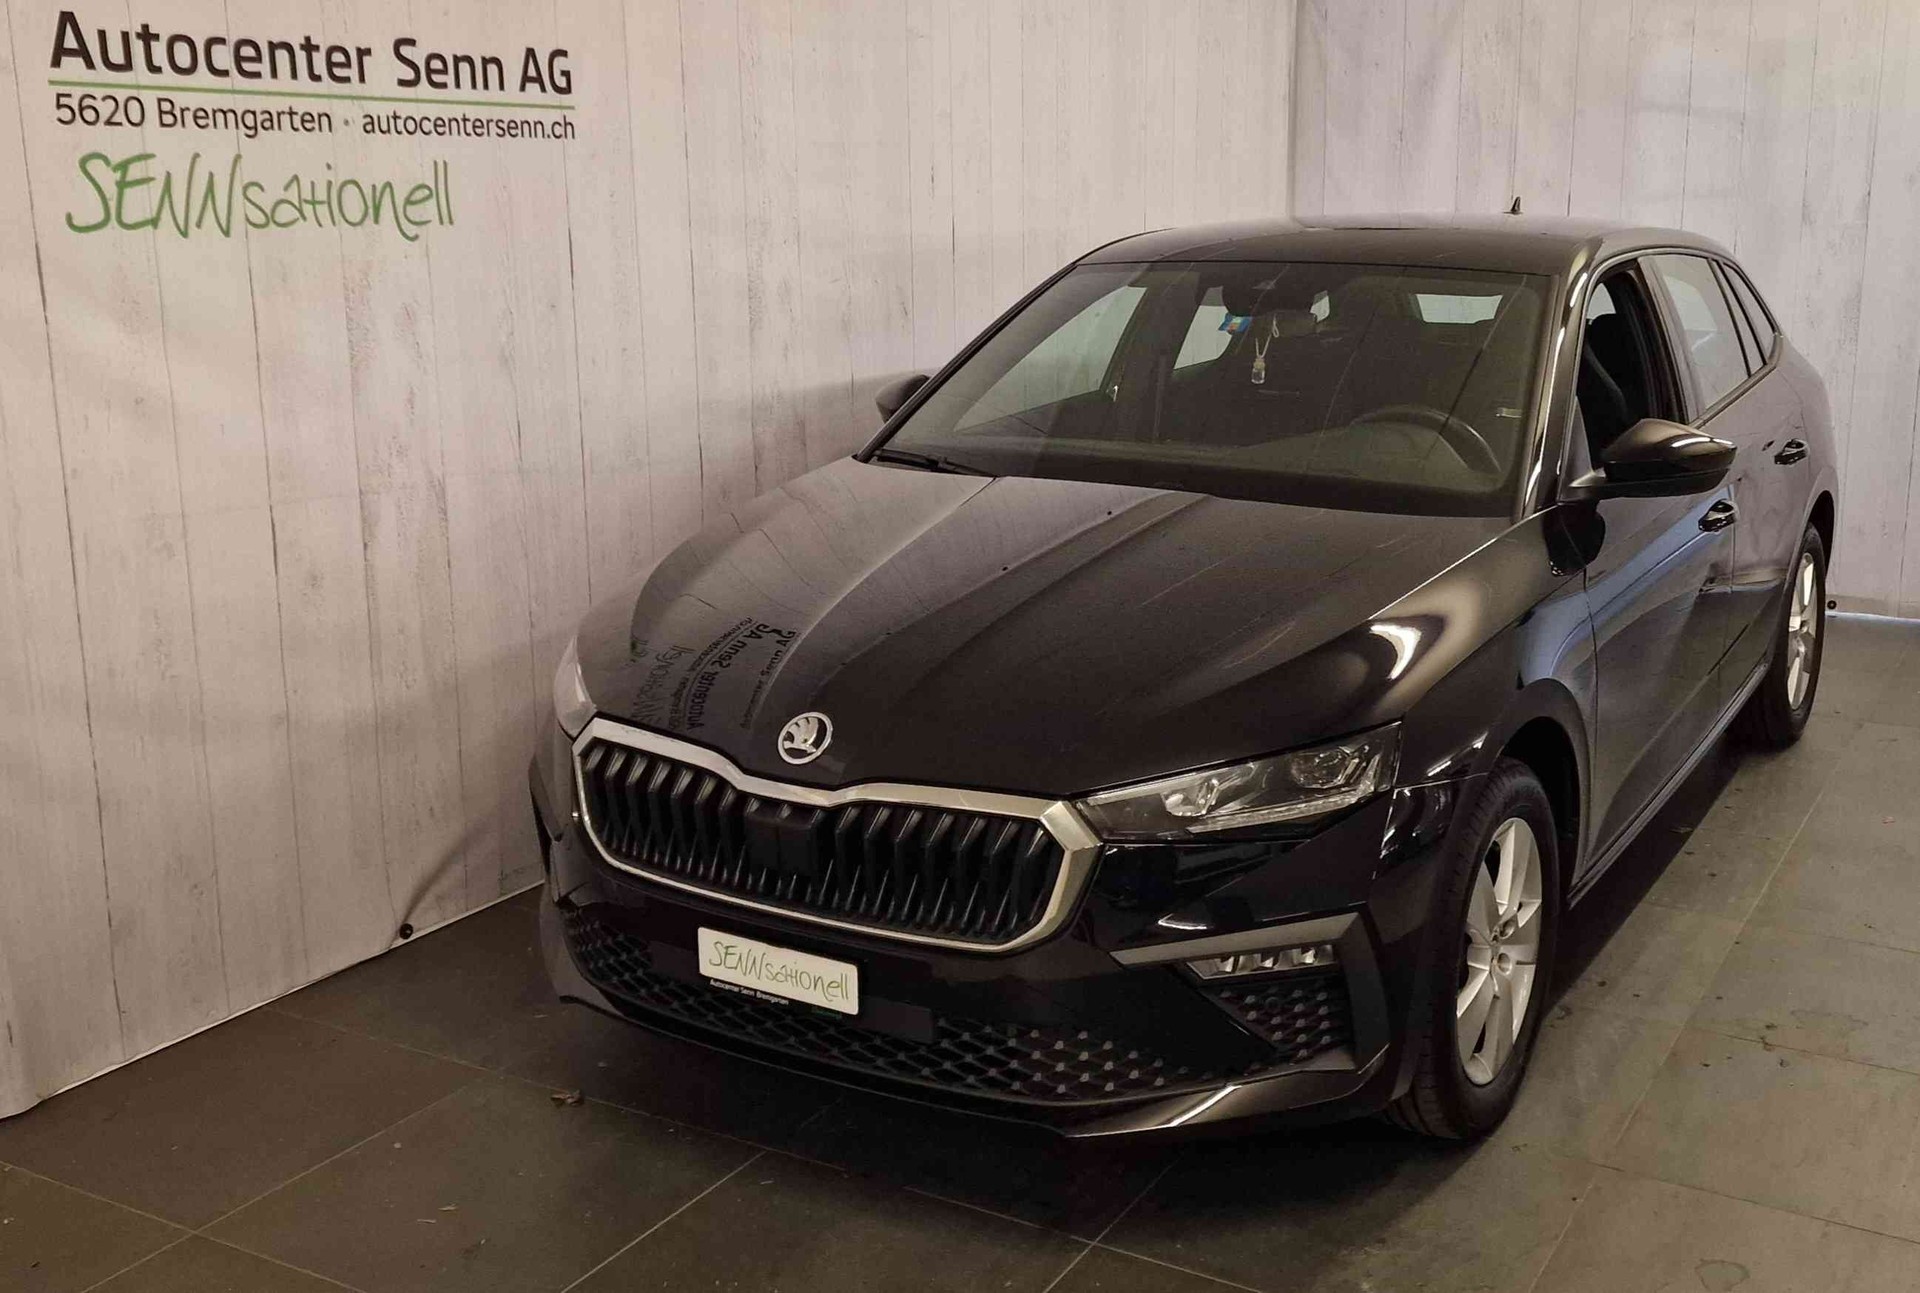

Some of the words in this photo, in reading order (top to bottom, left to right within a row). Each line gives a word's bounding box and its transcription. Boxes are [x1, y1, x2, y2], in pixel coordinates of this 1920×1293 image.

[50, 10, 372, 84] Autocenter
[392, 38, 505, 93] Senn
[518, 46, 573, 95] AG
[54, 93, 145, 128] 5620
[157, 97, 333, 138] Bremgarten
[361, 109, 576, 140] autocentersenn.ch
[65, 152, 455, 242] SENNsationell
[709, 941, 849, 1001] SENNsationell
